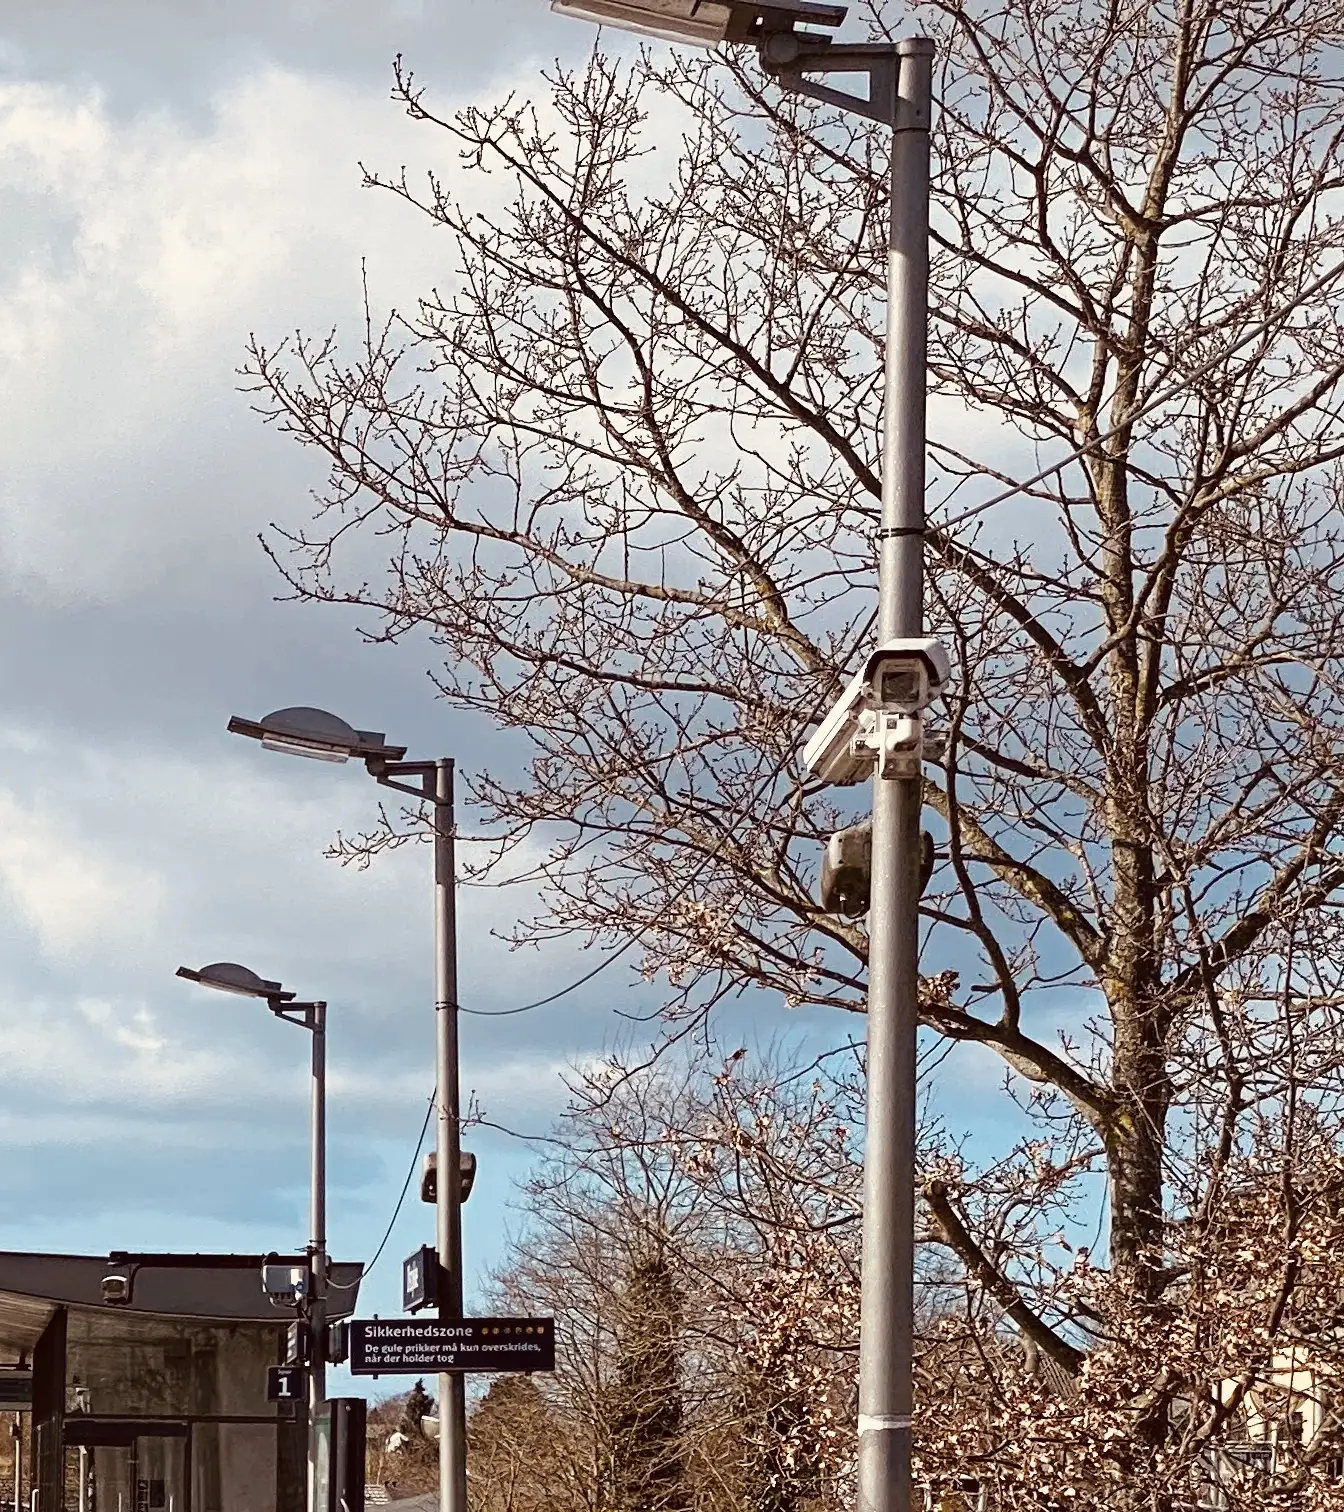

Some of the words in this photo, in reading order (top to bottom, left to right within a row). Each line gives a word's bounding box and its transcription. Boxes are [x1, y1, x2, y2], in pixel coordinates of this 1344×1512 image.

[364, 1325, 473, 1338] Sikkerhedszone
[365, 1343, 379, 1353] De
[381, 1343, 403, 1354] gule
[405, 1343, 440, 1354] prikker
[442, 1342, 458, 1352] må
[460, 1342, 479, 1352] kun
[481, 1341, 542, 1352] overskrides,
[364, 1353, 382, 1363] når
[383, 1353, 401, 1363] der
[402, 1353, 436, 1363] holder
[437, 1354, 454, 1364] tog
[277, 1376, 292, 1397] 1
